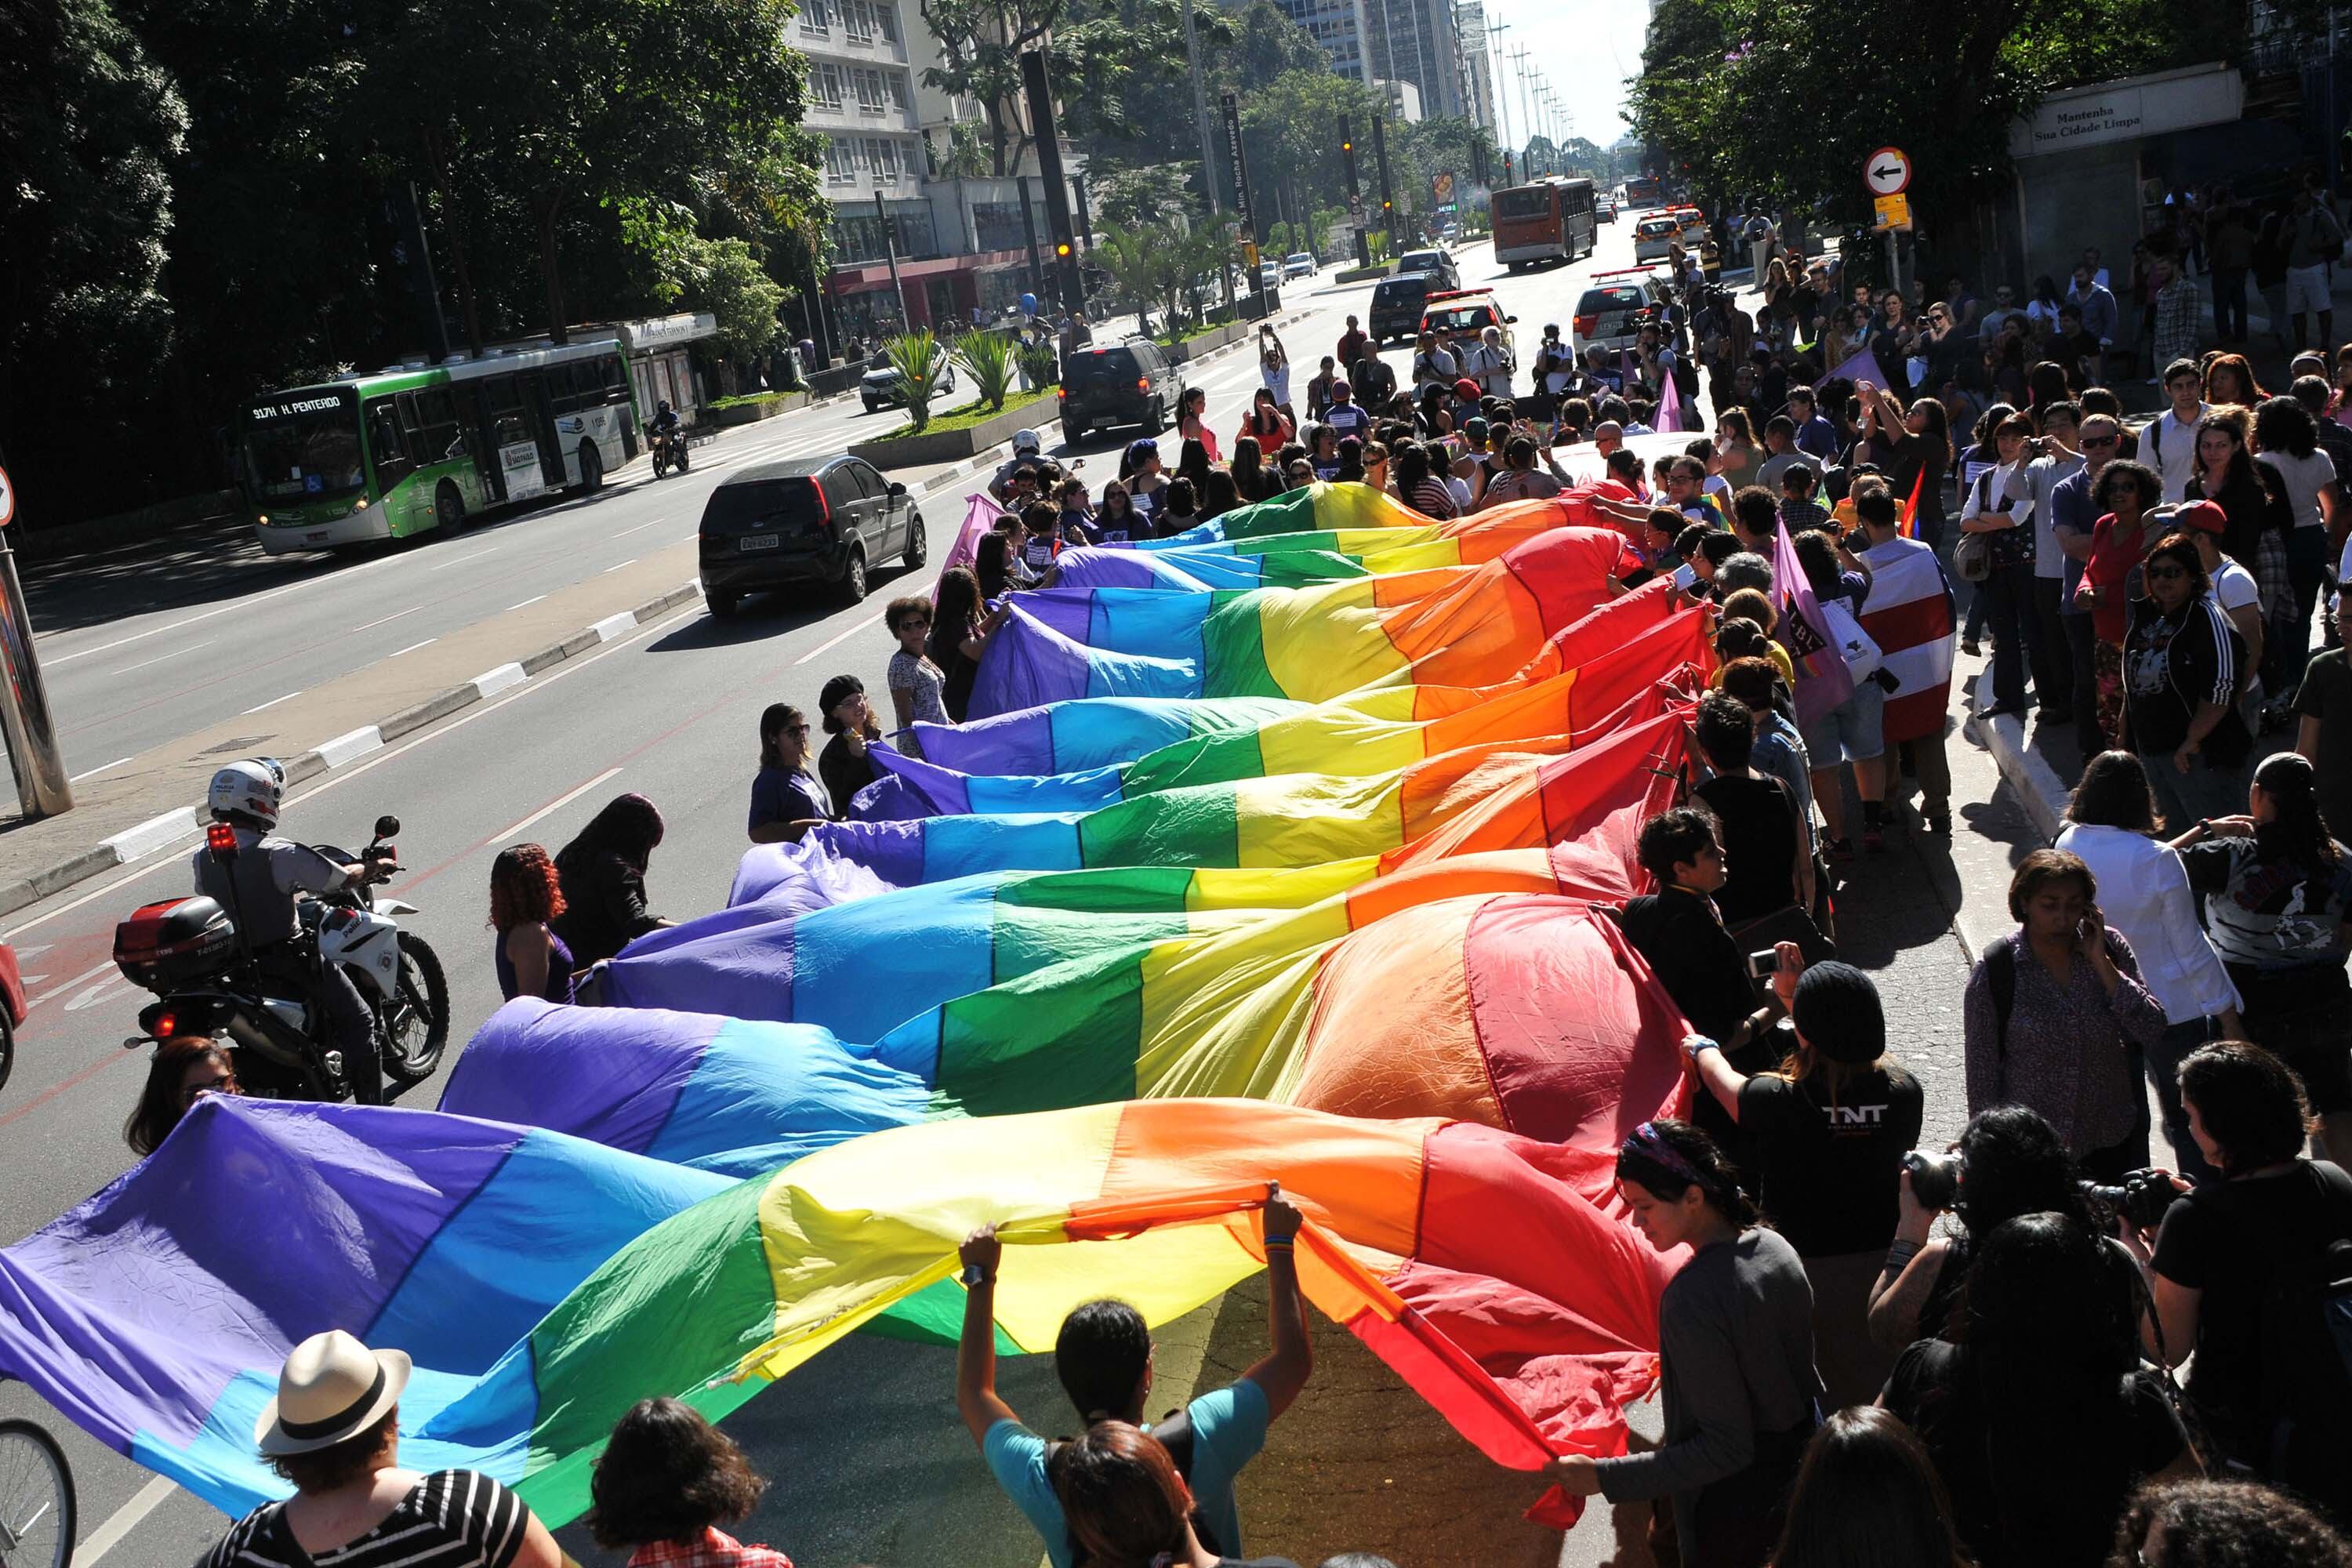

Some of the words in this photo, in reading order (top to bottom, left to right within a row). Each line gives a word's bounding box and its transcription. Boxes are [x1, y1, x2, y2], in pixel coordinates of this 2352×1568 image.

[2057, 107, 2114, 124] Mantenha
[1227, 119, 1238, 157] Azevedo
[2035, 130, 2057, 141] Sua
[2060, 122, 2101, 137] Cidade
[2104, 117, 2140, 130] Limpa
[1233, 160, 1243, 187] Rocha
[252, 407, 278, 419] 917H
[281, 405, 292, 415] H.
[292, 396, 341, 413] PENTEADO
[1821, 1105, 1888, 1123] TNT
